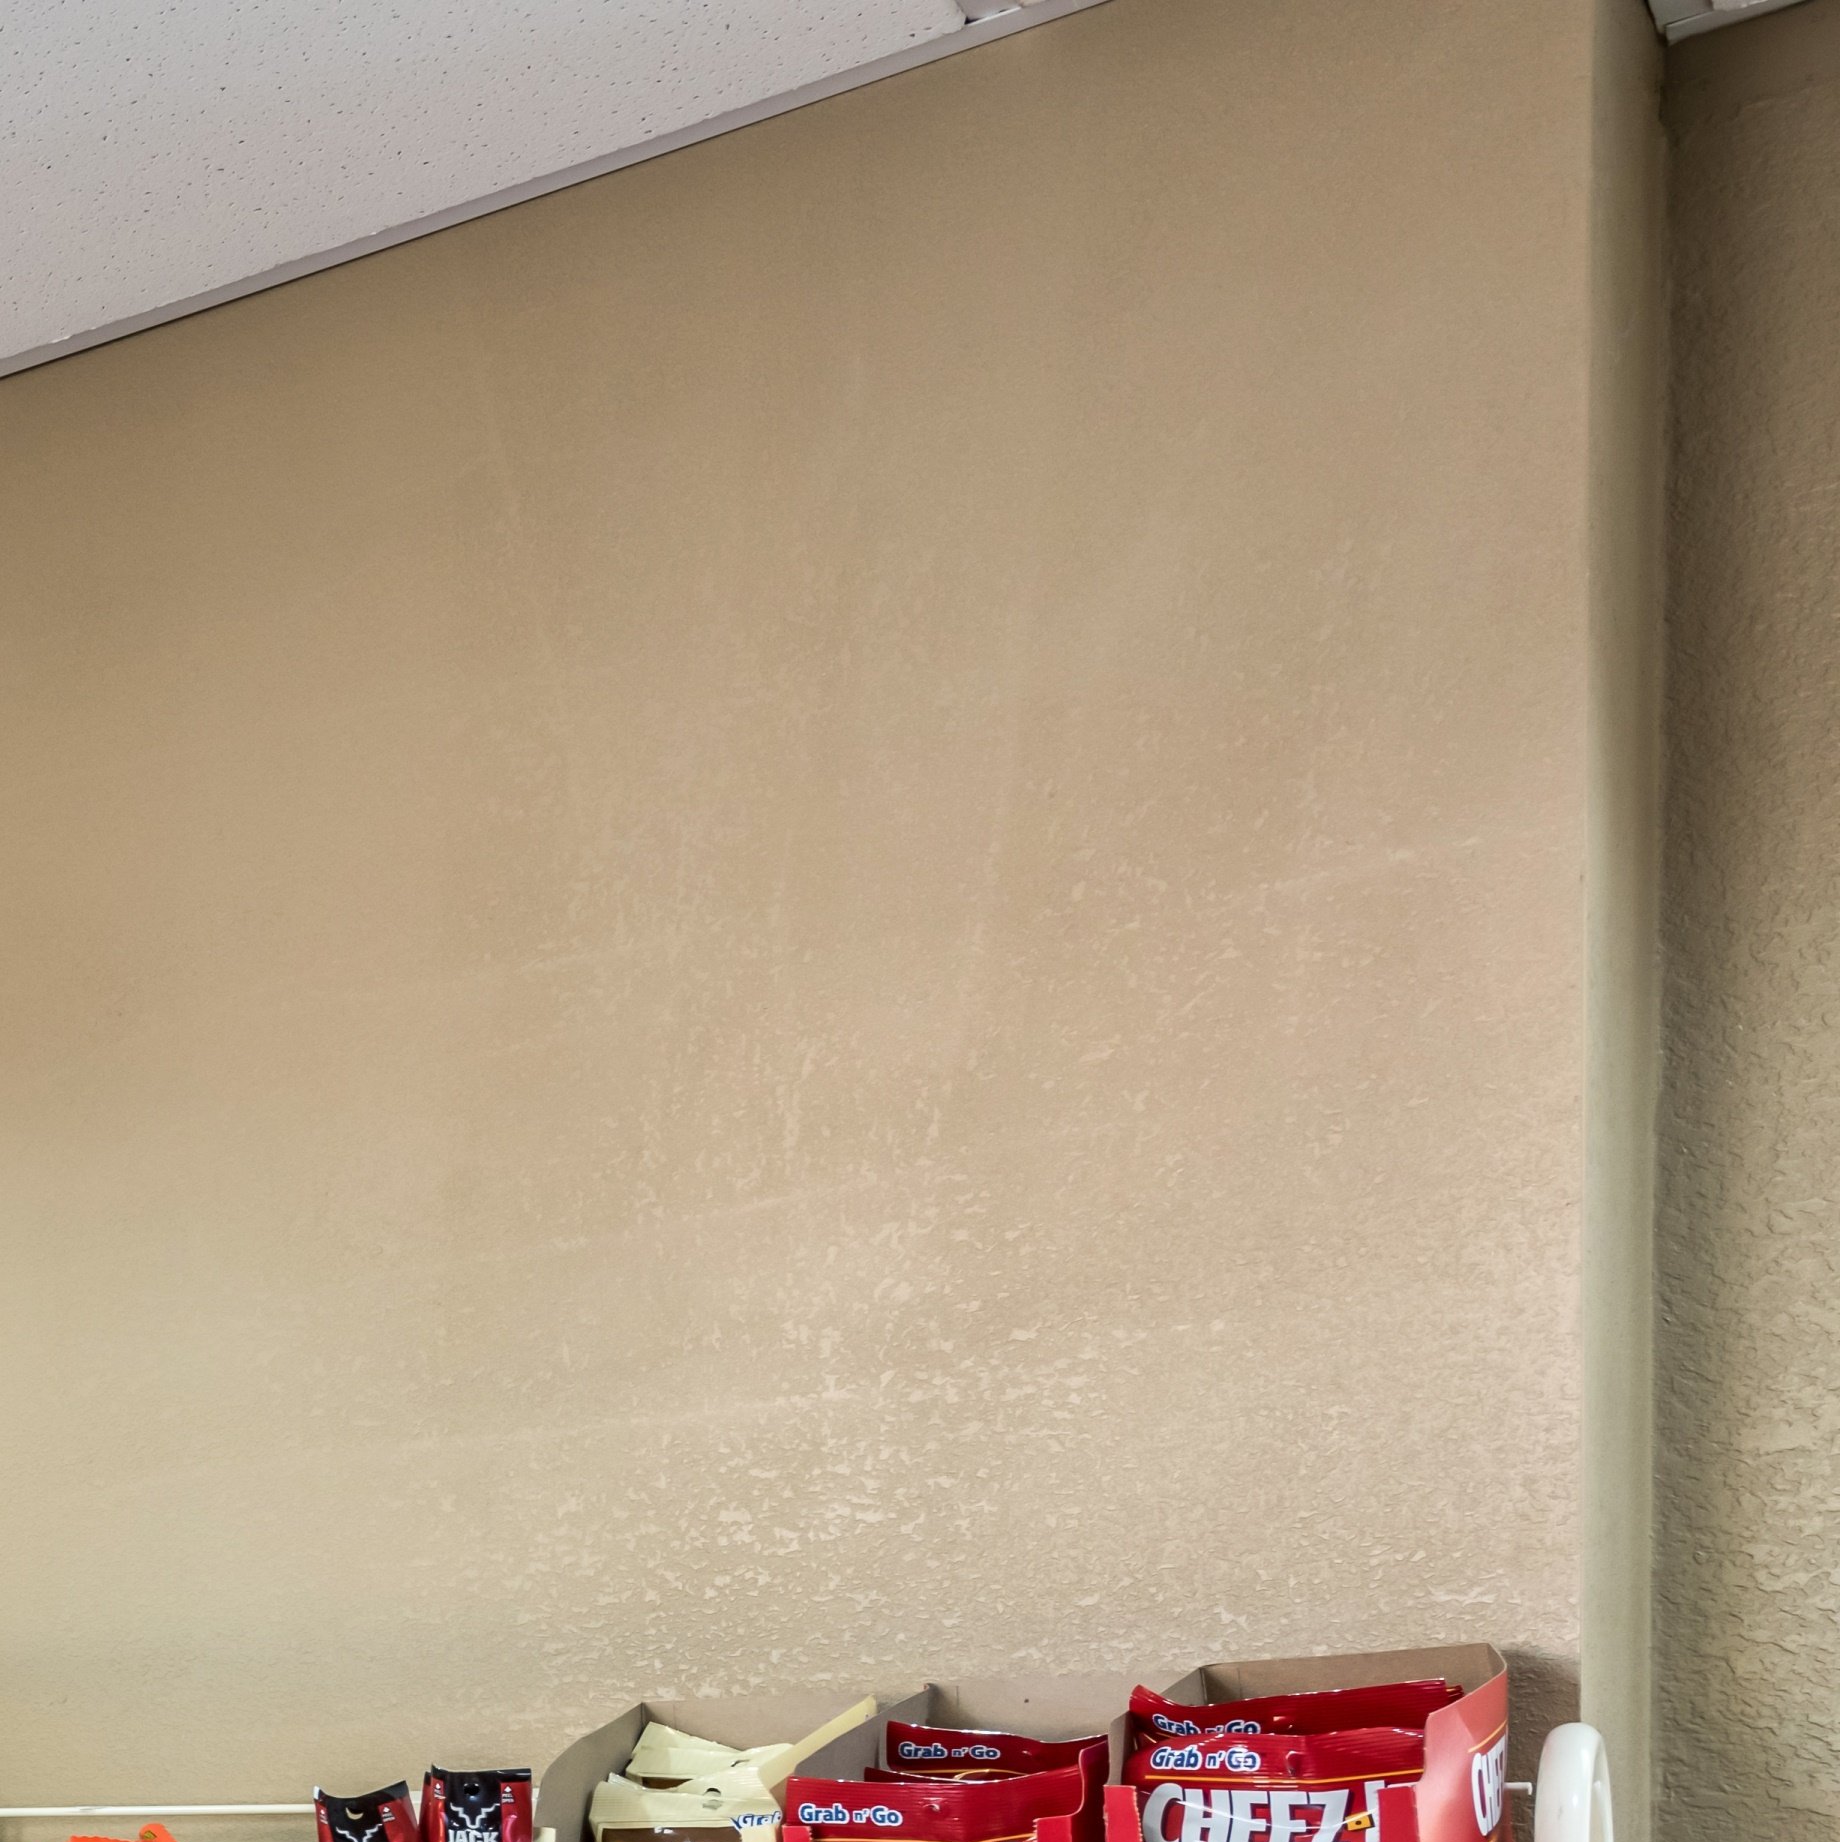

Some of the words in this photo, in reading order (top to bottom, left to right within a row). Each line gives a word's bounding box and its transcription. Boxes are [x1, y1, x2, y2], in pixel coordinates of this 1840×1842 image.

[898, 1742, 946, 1759] Grab
[970, 1746, 1000, 1761] Go
[1151, 1747, 1199, 1769] Grab
[1226, 1748, 1260, 1771] Go
[800, 1804, 849, 1823] Grab
[872, 1807, 902, 1825] Go
